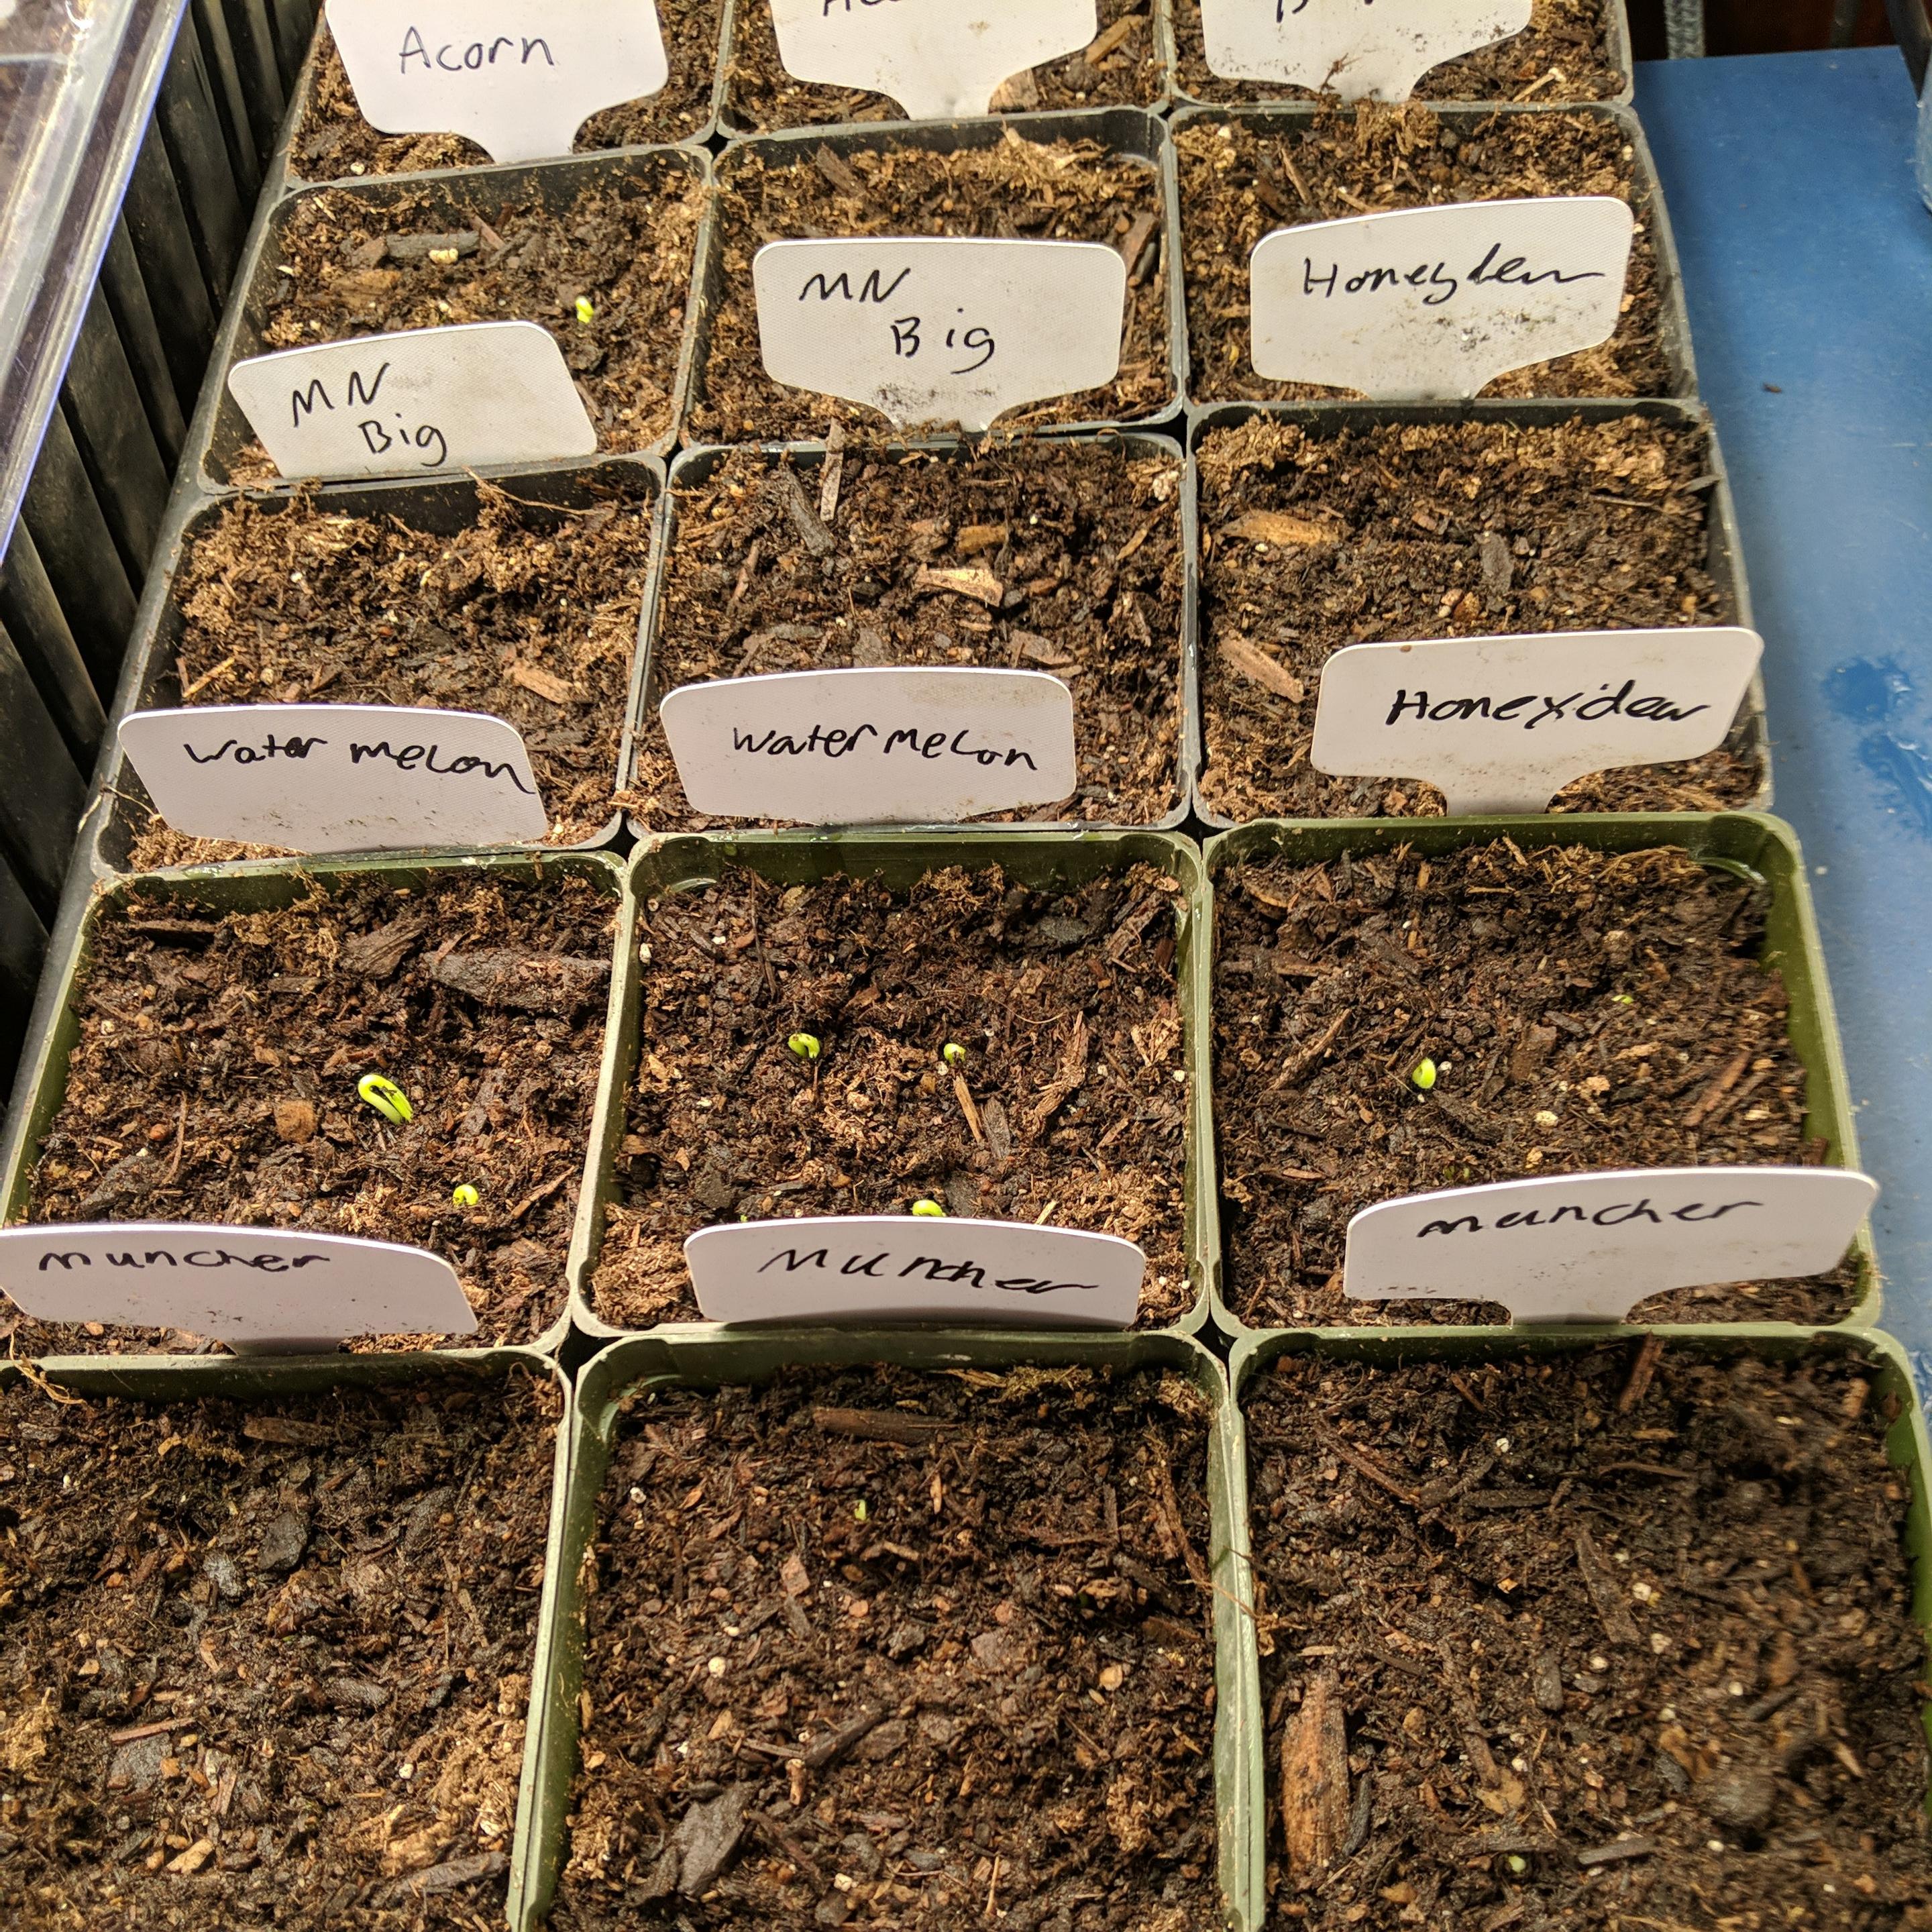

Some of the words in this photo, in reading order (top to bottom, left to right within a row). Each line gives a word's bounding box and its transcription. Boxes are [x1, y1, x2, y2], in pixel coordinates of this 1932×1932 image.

[399, 26, 554, 72] Acorn
[798, 268, 911, 303] MN
[890, 308, 995, 374] Big
[292, 362, 390, 429] MN
[358, 413, 447, 468] Big
